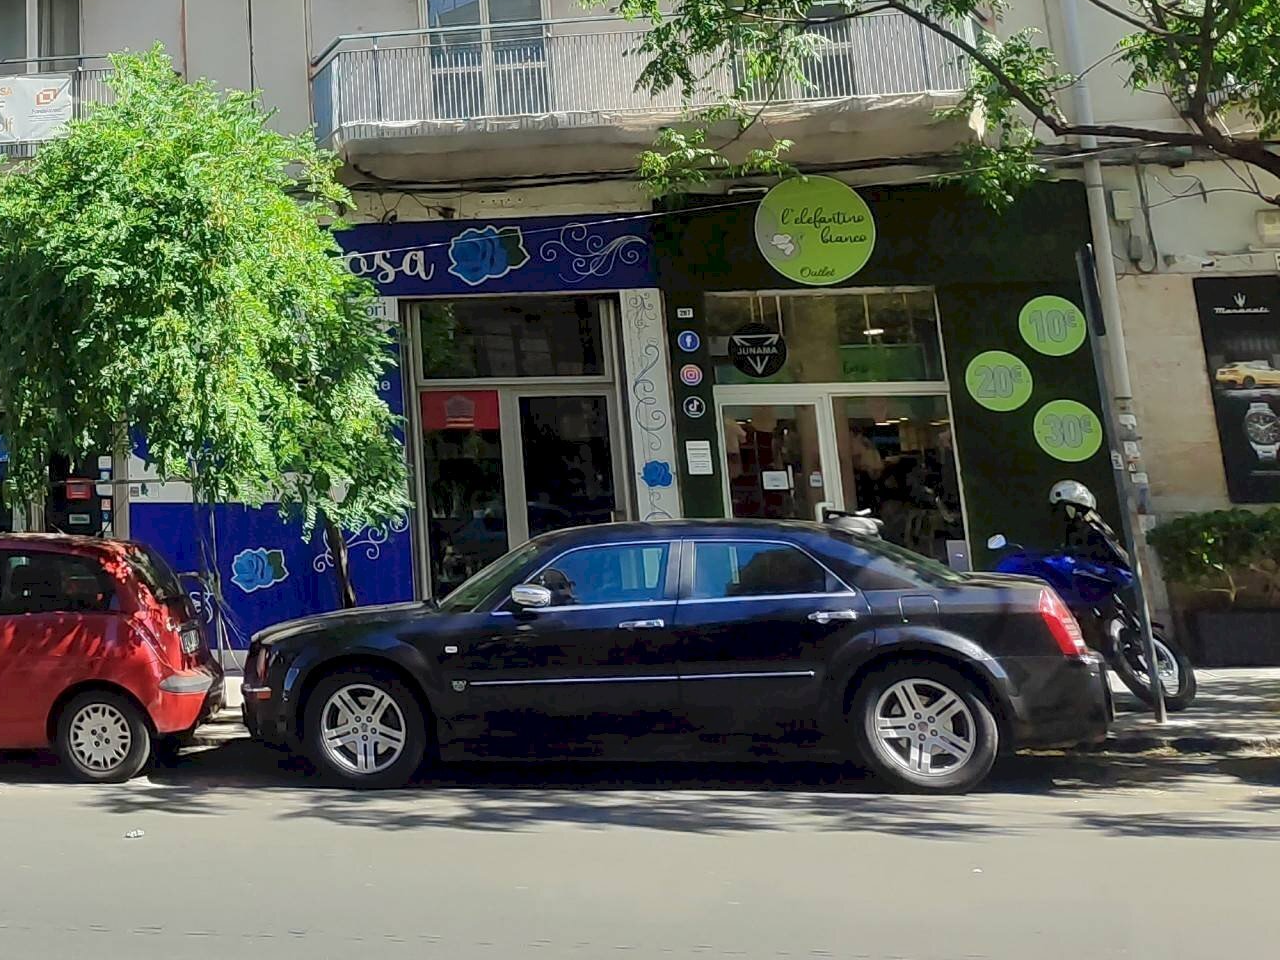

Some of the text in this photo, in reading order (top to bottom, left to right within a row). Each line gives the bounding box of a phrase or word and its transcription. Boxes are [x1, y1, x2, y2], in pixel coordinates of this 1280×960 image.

[820, 225, 867, 245] bianco
[344, 249, 435, 284] osa
[800, 266, 836, 279] Outlet
[737, 346, 779, 356] JUNAMA
